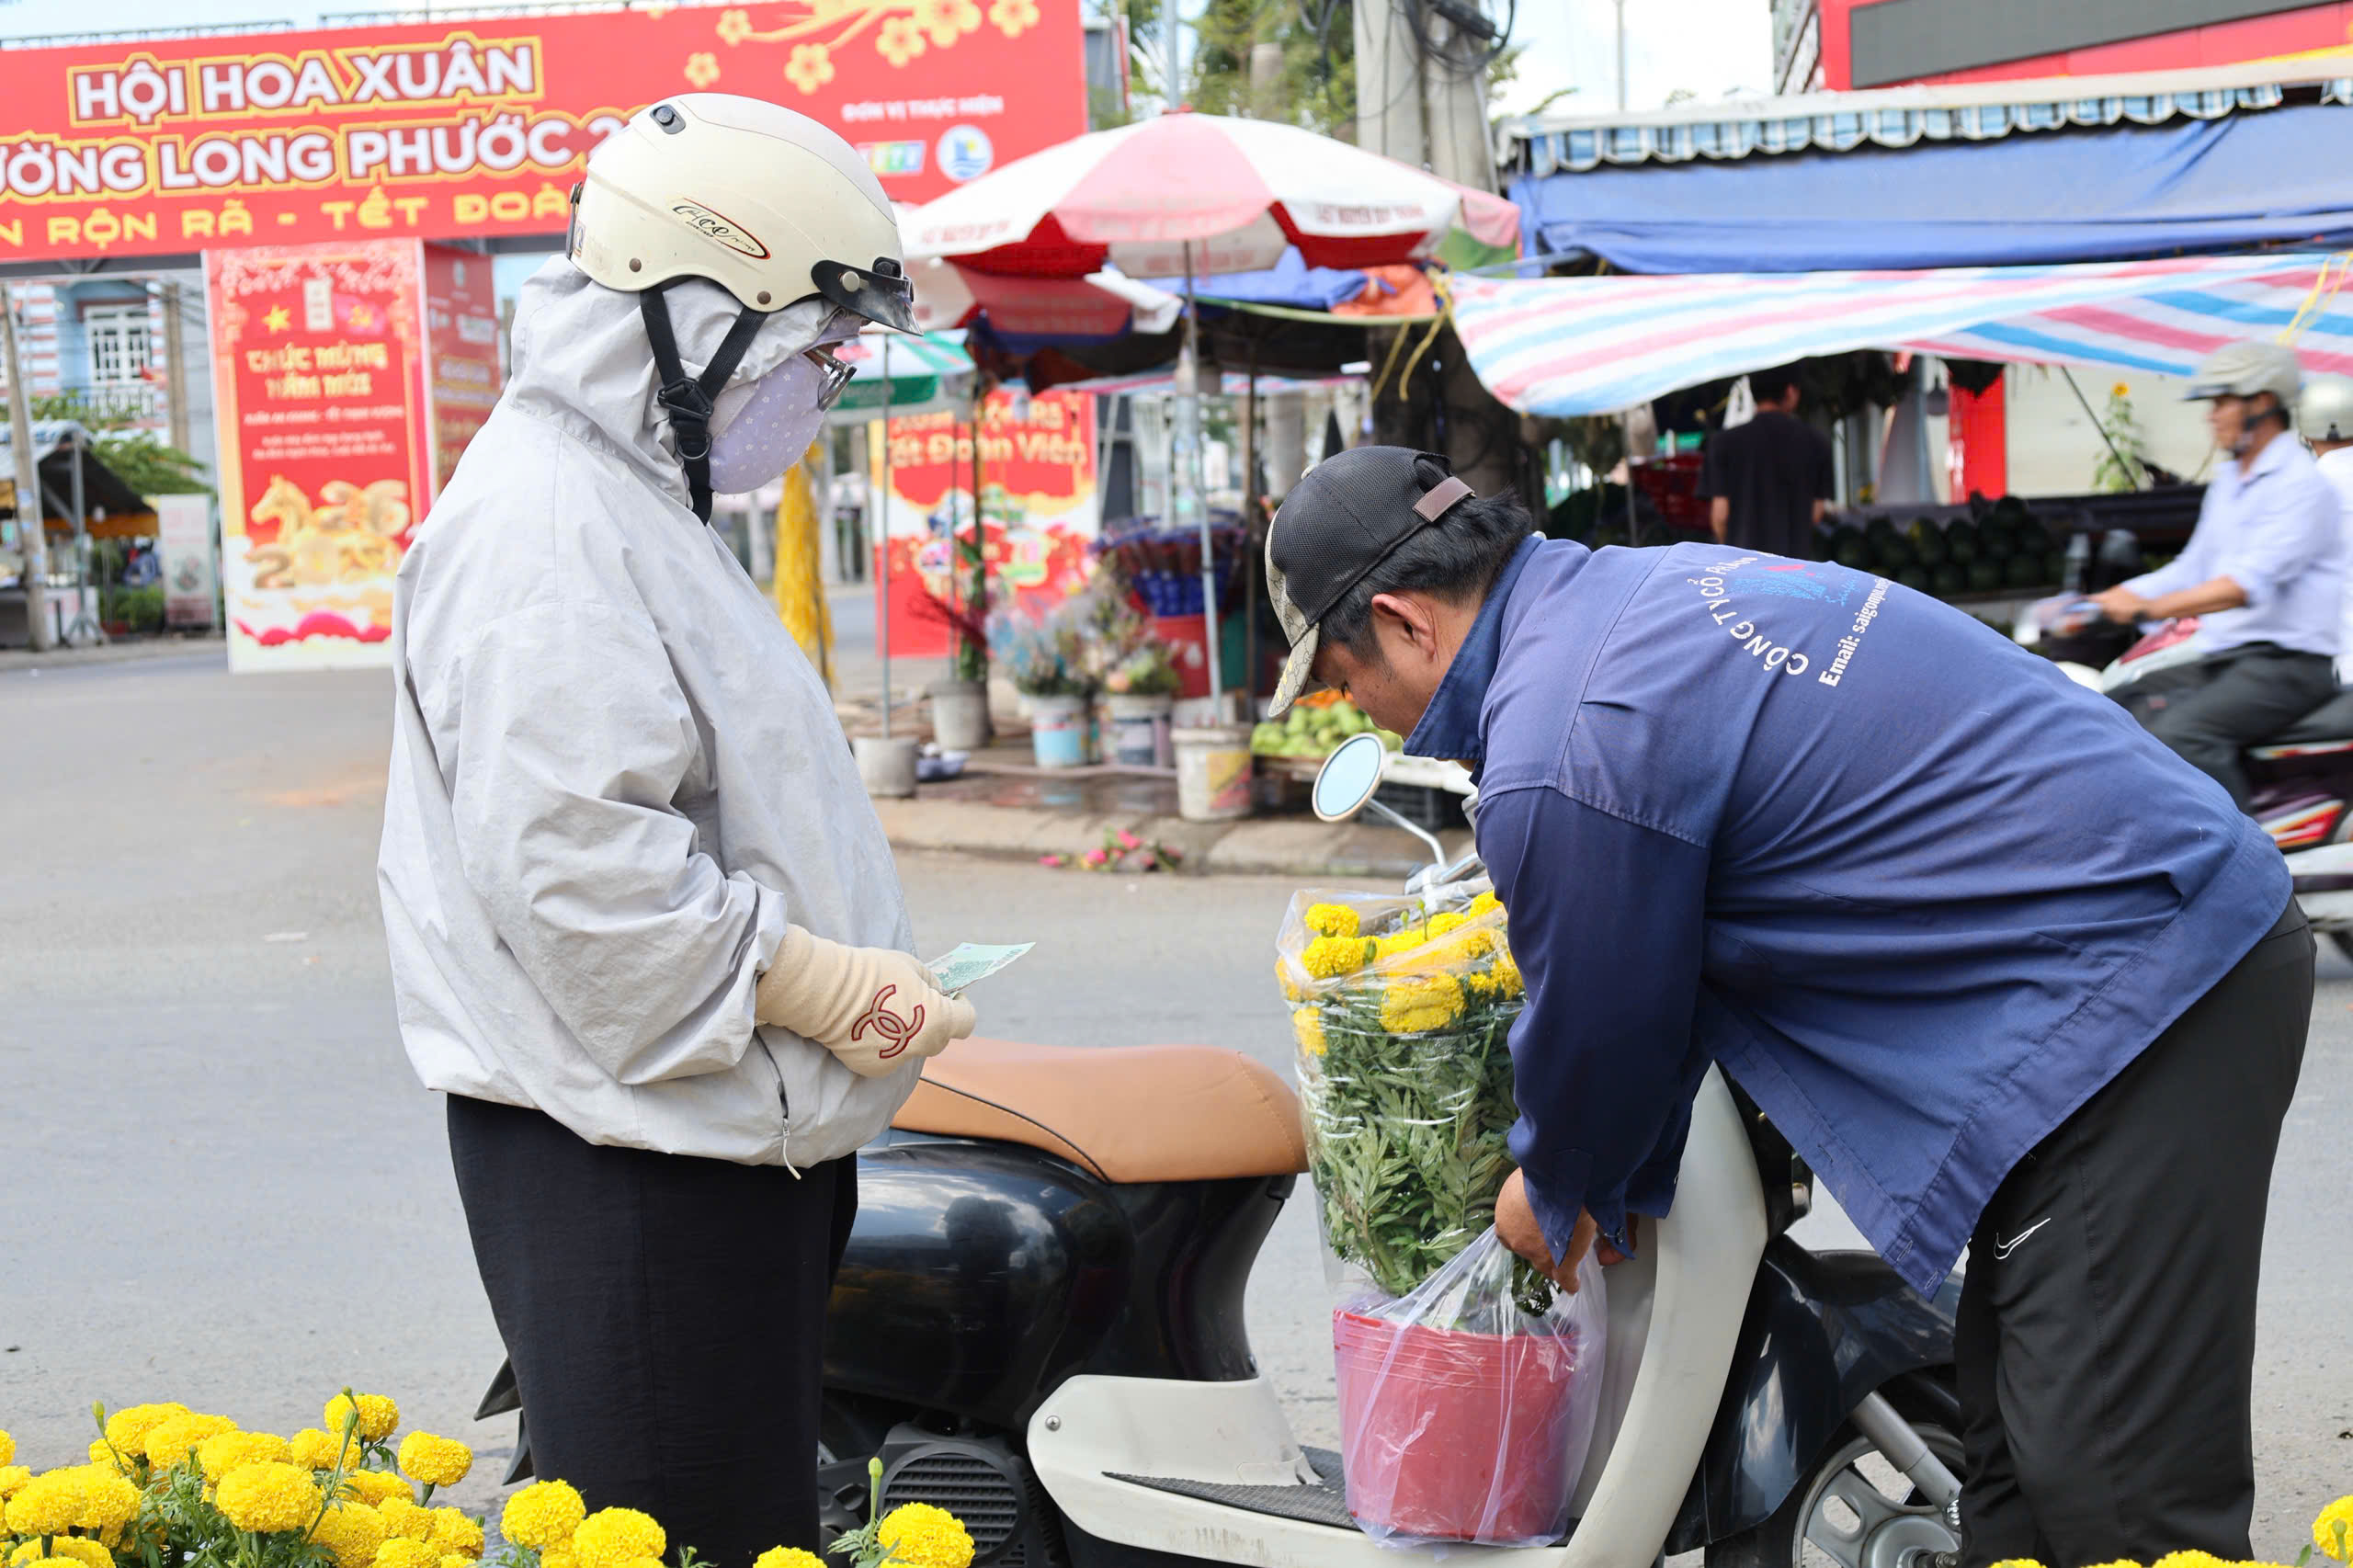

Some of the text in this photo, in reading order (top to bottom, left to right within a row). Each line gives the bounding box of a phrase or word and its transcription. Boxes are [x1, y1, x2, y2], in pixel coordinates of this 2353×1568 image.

[76, 40, 534, 123] HỘI HOA XUÂN
[0, 142, 147, 196] ỜNG
[160, 133, 333, 189] LONG
[349, 114, 573, 176] PHƯỚC
[47, 208, 157, 250] RỘN
[183, 199, 253, 240] RÃ
[321, 185, 428, 230] TẾT
[1706, 598, 1737, 626] TY
[1818, 635, 1860, 687] Email:
